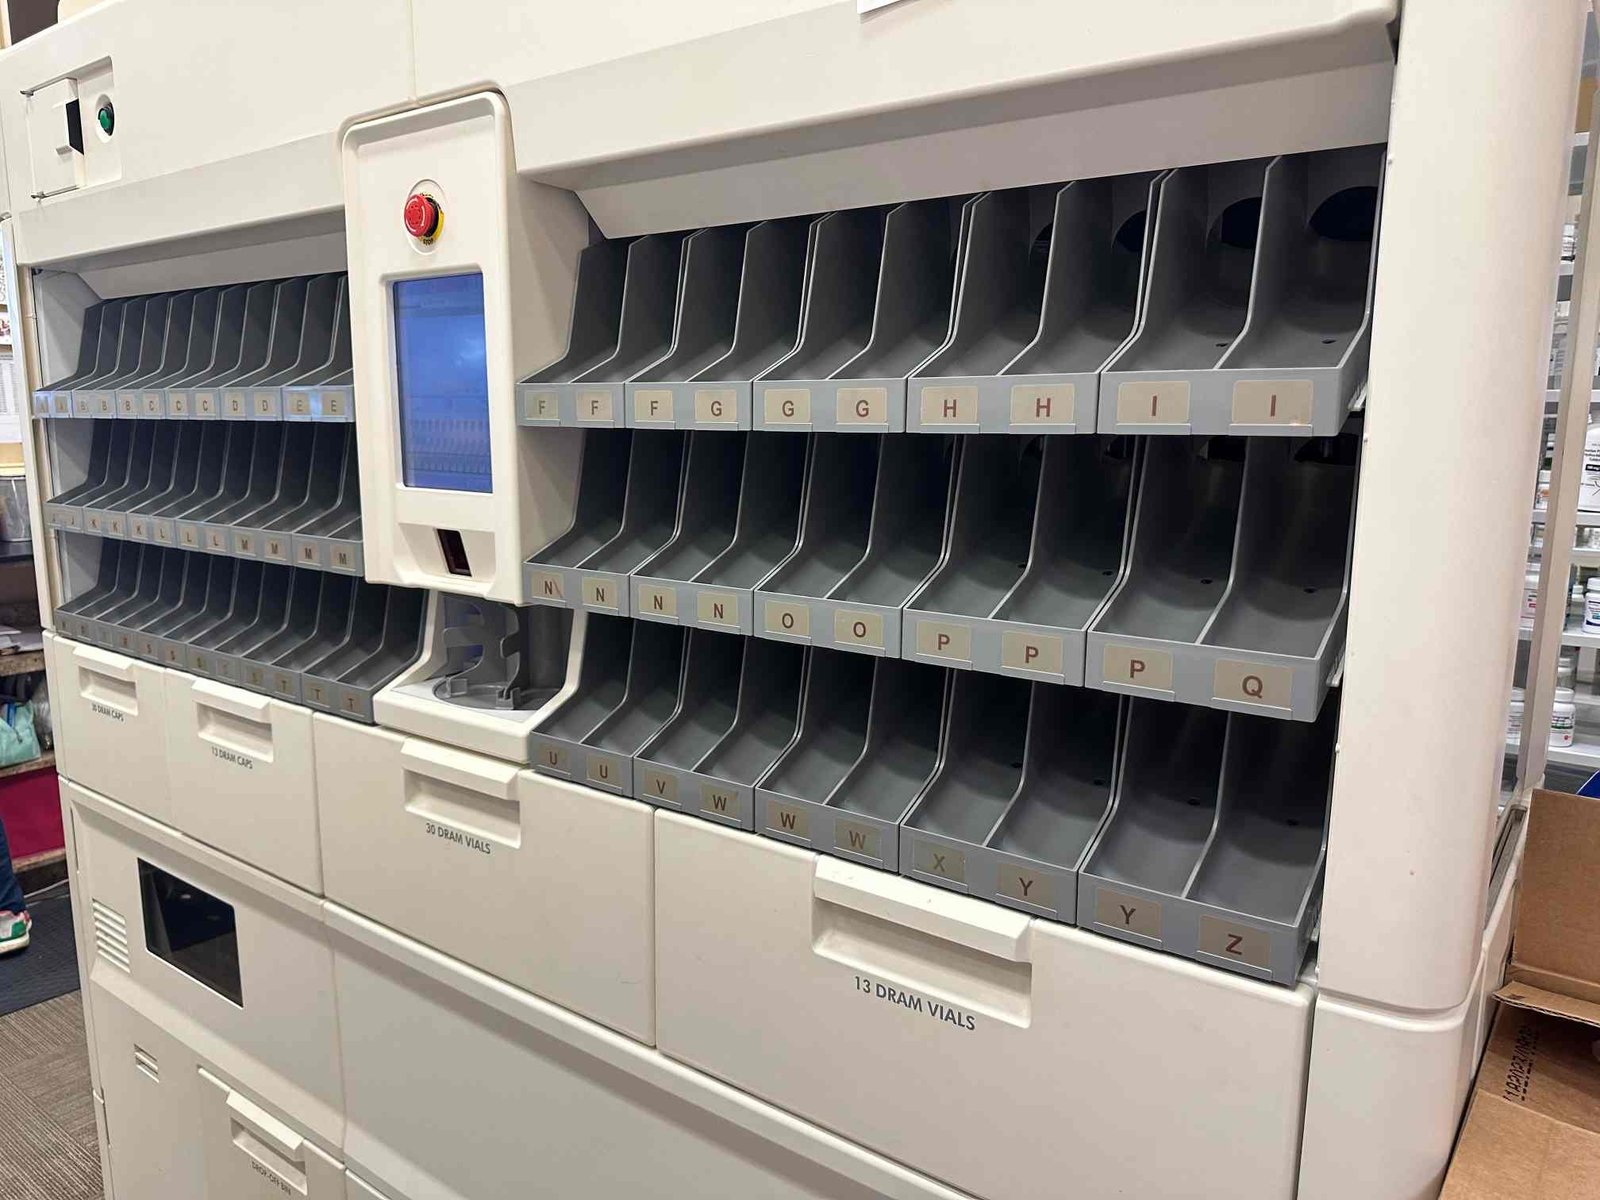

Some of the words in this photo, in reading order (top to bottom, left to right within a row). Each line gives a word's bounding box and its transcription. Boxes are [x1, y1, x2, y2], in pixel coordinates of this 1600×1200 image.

[102, 400, 107, 411] B
[125, 400, 131, 411] B
[149, 400, 154, 411] C
[176, 400, 182, 411] C
[203, 400, 208, 411] C
[232, 400, 238, 411] D
[262, 400, 268, 411] D
[297, 400, 303, 412] E
[331, 400, 337, 412] E
[538, 400, 546, 415] F
[591, 400, 599, 415] F
[650, 400, 659, 416] F
[710, 400, 722, 417] G
[781, 400, 795, 417] G
[855, 399, 870, 418] G
[943, 399, 957, 418] H
[1035, 397, 1052, 418] H
[1151, 395, 1158, 417] I
[1270, 394, 1277, 417] I
[113, 521, 119, 532] K
[160, 528, 165, 539] L
[186, 532, 192, 543] L
[213, 535, 219, 547] L
[241, 539, 249, 551] M
[271, 543, 278, 554] M
[304, 547, 313, 560] M
[338, 552, 347, 565] M
[544, 580, 553, 595] N
[596, 587, 605, 603] N
[653, 595, 663, 611] N
[713, 603, 724, 619] N
[781, 612, 795, 629] O
[852, 621, 867, 638] O
[937, 633, 950, 651] P
[1025, 646, 1039, 664] P
[1129, 659, 1146, 679] P
[281, 680, 287, 692] T
[315, 688, 321, 700] T
[1241, 675, 1264, 699] Q
[348, 697, 355, 711] T
[219, 749, 236, 764] DRAM
[237, 756, 253, 770] CAPS
[549, 751, 558, 766] U
[599, 765, 608, 779] U
[655, 779, 666, 794] V
[712, 794, 727, 812] W
[780, 811, 796, 830] W
[426, 822, 436, 835] 30
[437, 826, 464, 845] DRAM
[465, 835, 491, 854] VIALS
[848, 830, 866, 850] W
[933, 853, 946, 873] X
[1018, 876, 1033, 897] Y
[1120, 904, 1137, 925] Y
[1225, 933, 1243, 955] Z
[855, 975, 871, 994] 13
[875, 983, 923, 1013] DRAM
[927, 1000, 976, 1031] VIALS
